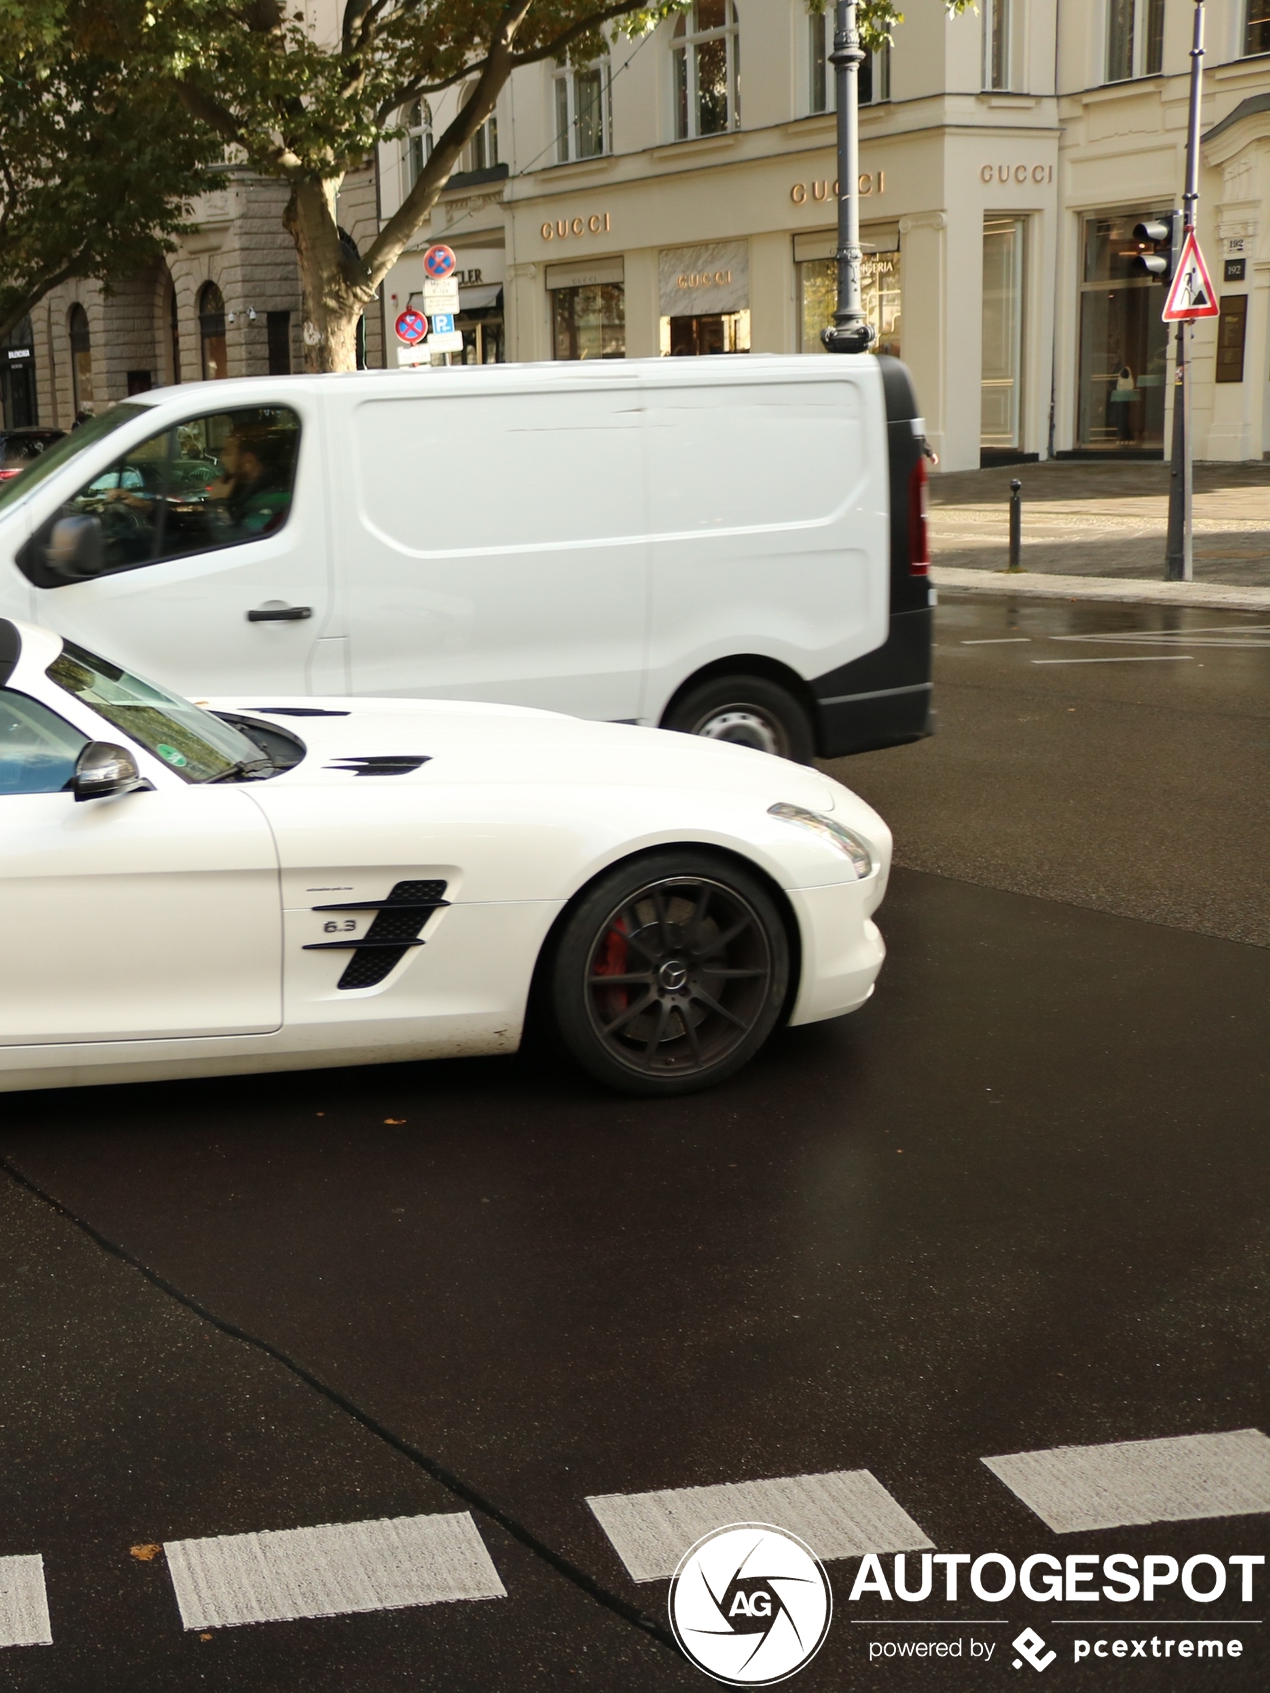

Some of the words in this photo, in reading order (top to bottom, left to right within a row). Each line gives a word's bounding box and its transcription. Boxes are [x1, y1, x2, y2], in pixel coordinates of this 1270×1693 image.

[980, 164, 1052, 183] GUCCI
[541, 212, 610, 241] GUCCI
[1229, 238, 1244, 248] 192
[452, 268, 483, 286] CLER
[1227, 265, 1241, 275] 192
[676, 270, 731, 290] GUCCI
[435, 315, 448, 332] P
[324, 919, 357, 933] 6.3
